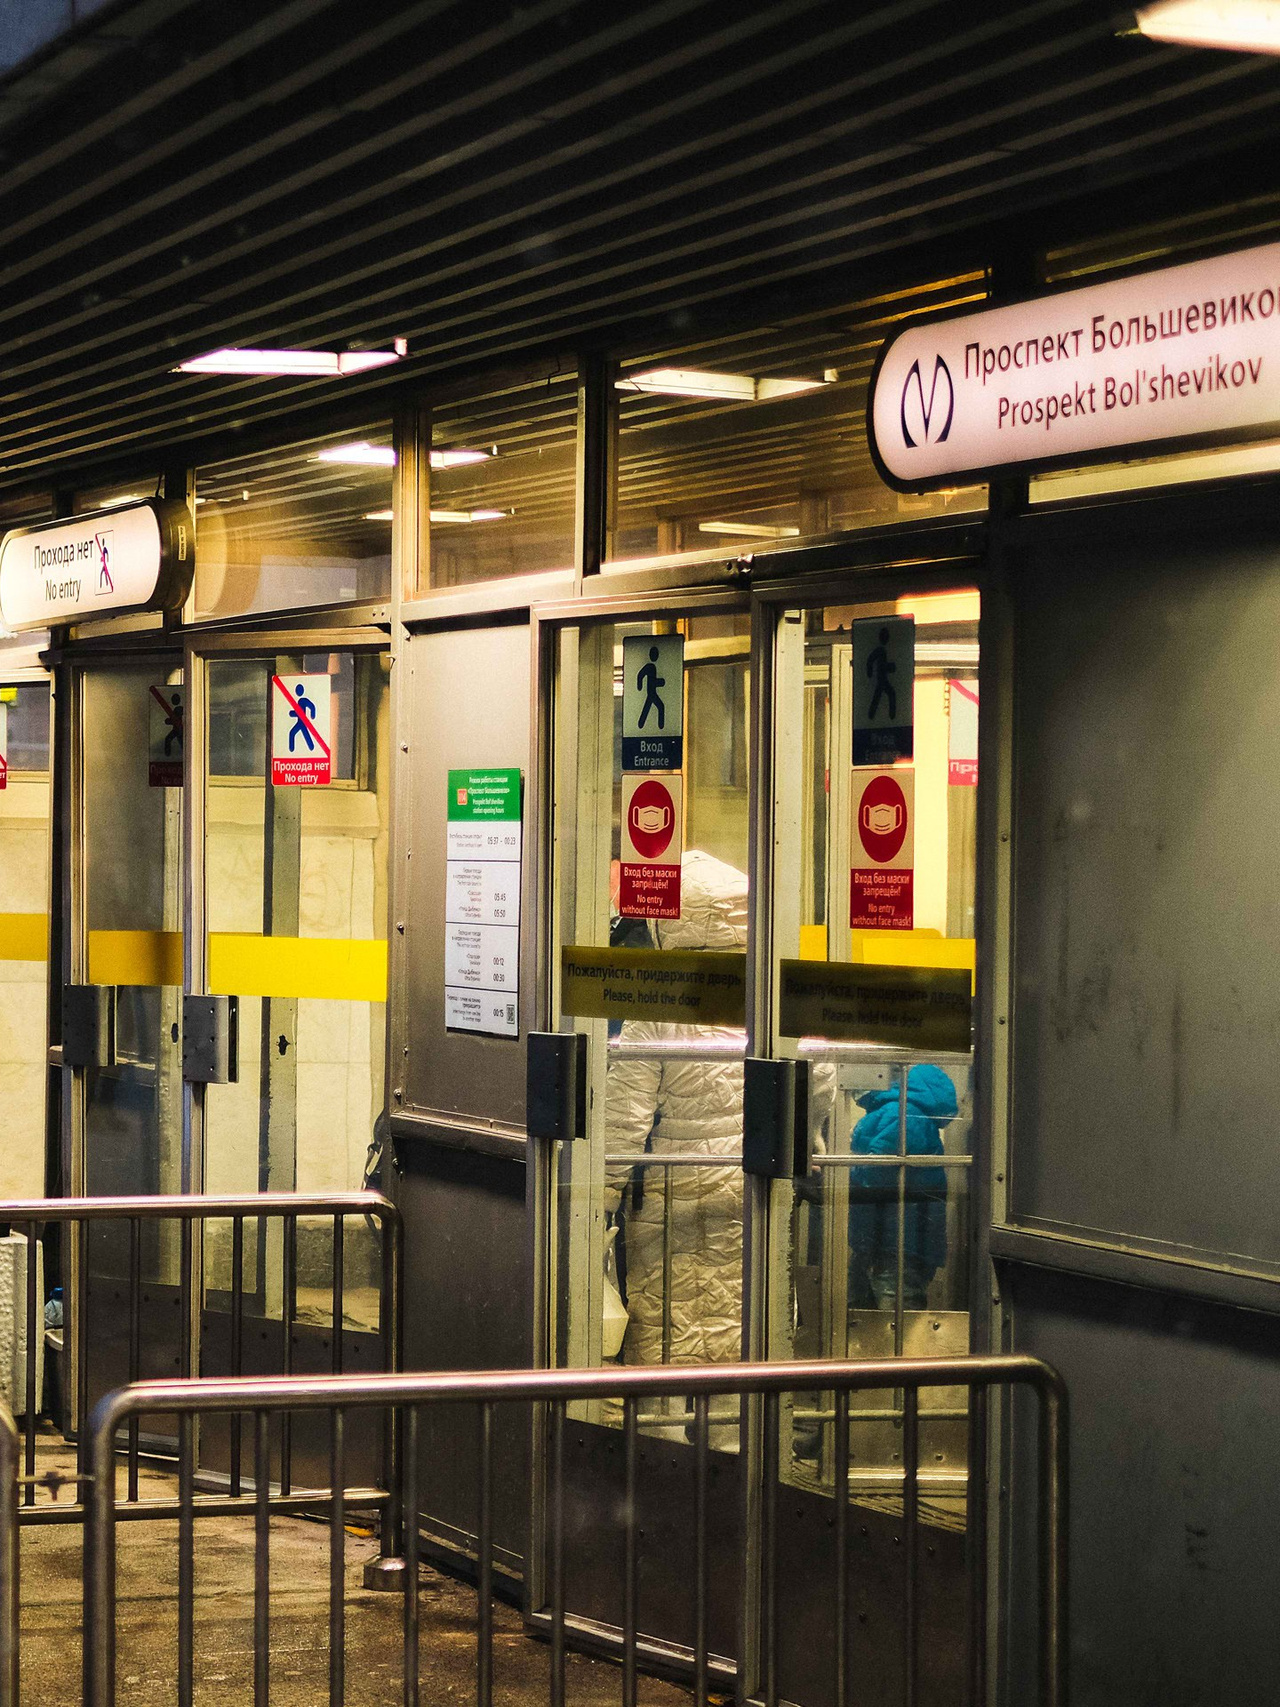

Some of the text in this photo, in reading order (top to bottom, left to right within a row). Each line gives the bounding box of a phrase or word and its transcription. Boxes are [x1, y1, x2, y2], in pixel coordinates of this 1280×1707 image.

[964, 286, 1280, 386] Проспект Большевико
[996, 354, 1263, 430] Prospekt Bol'shevikov
[34, 540, 94, 575] Прохода нет
[45, 577, 82, 603] No entry
[640, 740, 663, 754] Вход
[273, 760, 330, 774] Прохода нет
[634, 755, 669, 767] Entrance
[284, 773, 319, 785] No entry
[624, 866, 677, 879] Вход без маски
[854, 872, 910, 886] Вход без маски
[631, 879, 669, 891] запрещён!
[637, 894, 664, 907] No entry
[621, 904, 678, 916] without face mask!
[867, 903, 896, 916] No entry
[852, 915, 877, 925] without
[878, 915, 892, 926] face
[567, 963, 742, 989] Пожалуйста, придержите дверь
[603, 988, 701, 1007] Please, hold the door
